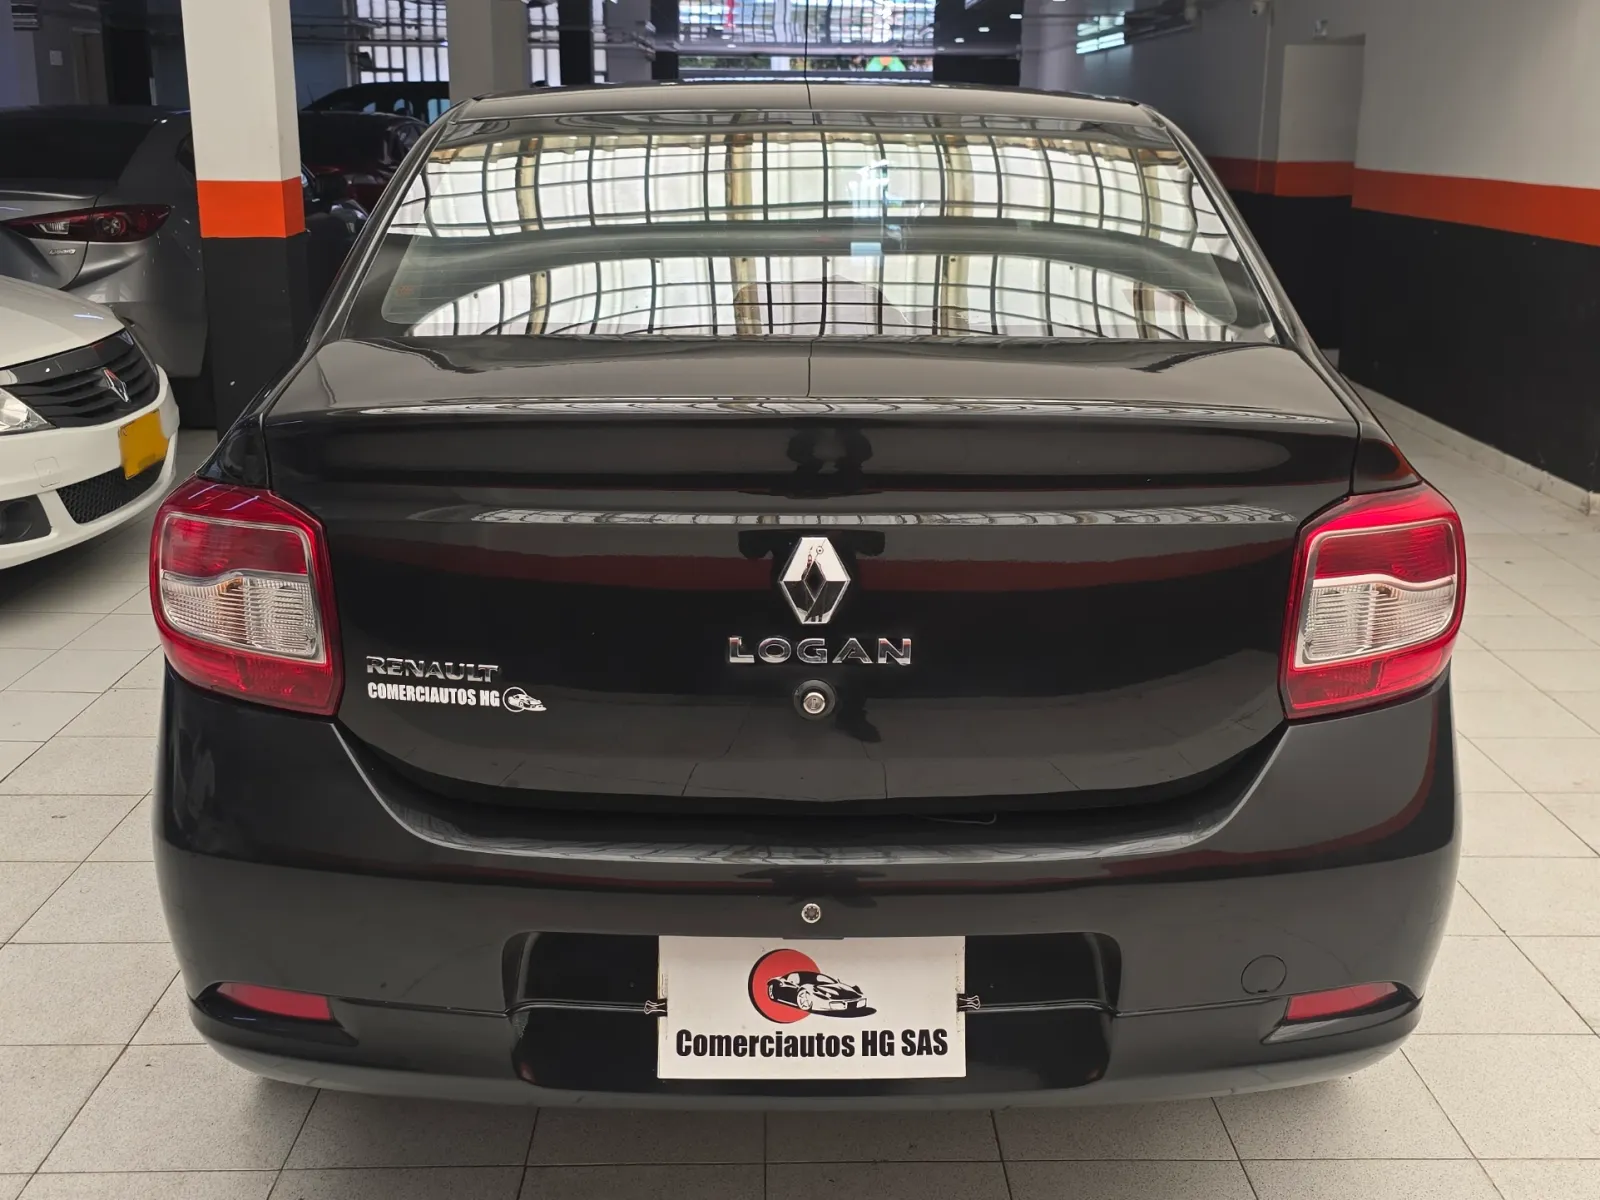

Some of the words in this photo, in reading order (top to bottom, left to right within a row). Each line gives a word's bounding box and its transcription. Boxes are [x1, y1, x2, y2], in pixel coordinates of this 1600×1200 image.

[728, 636, 912, 665] LOGAN
[366, 656, 499, 682] RENAULT
[367, 682, 476, 706] COMERCIAUTOS
[479, 690, 500, 707] HG
[676, 1029, 855, 1057] Comerciautos
[862, 1030, 895, 1056] HG
[901, 1029, 948, 1056] SAS
